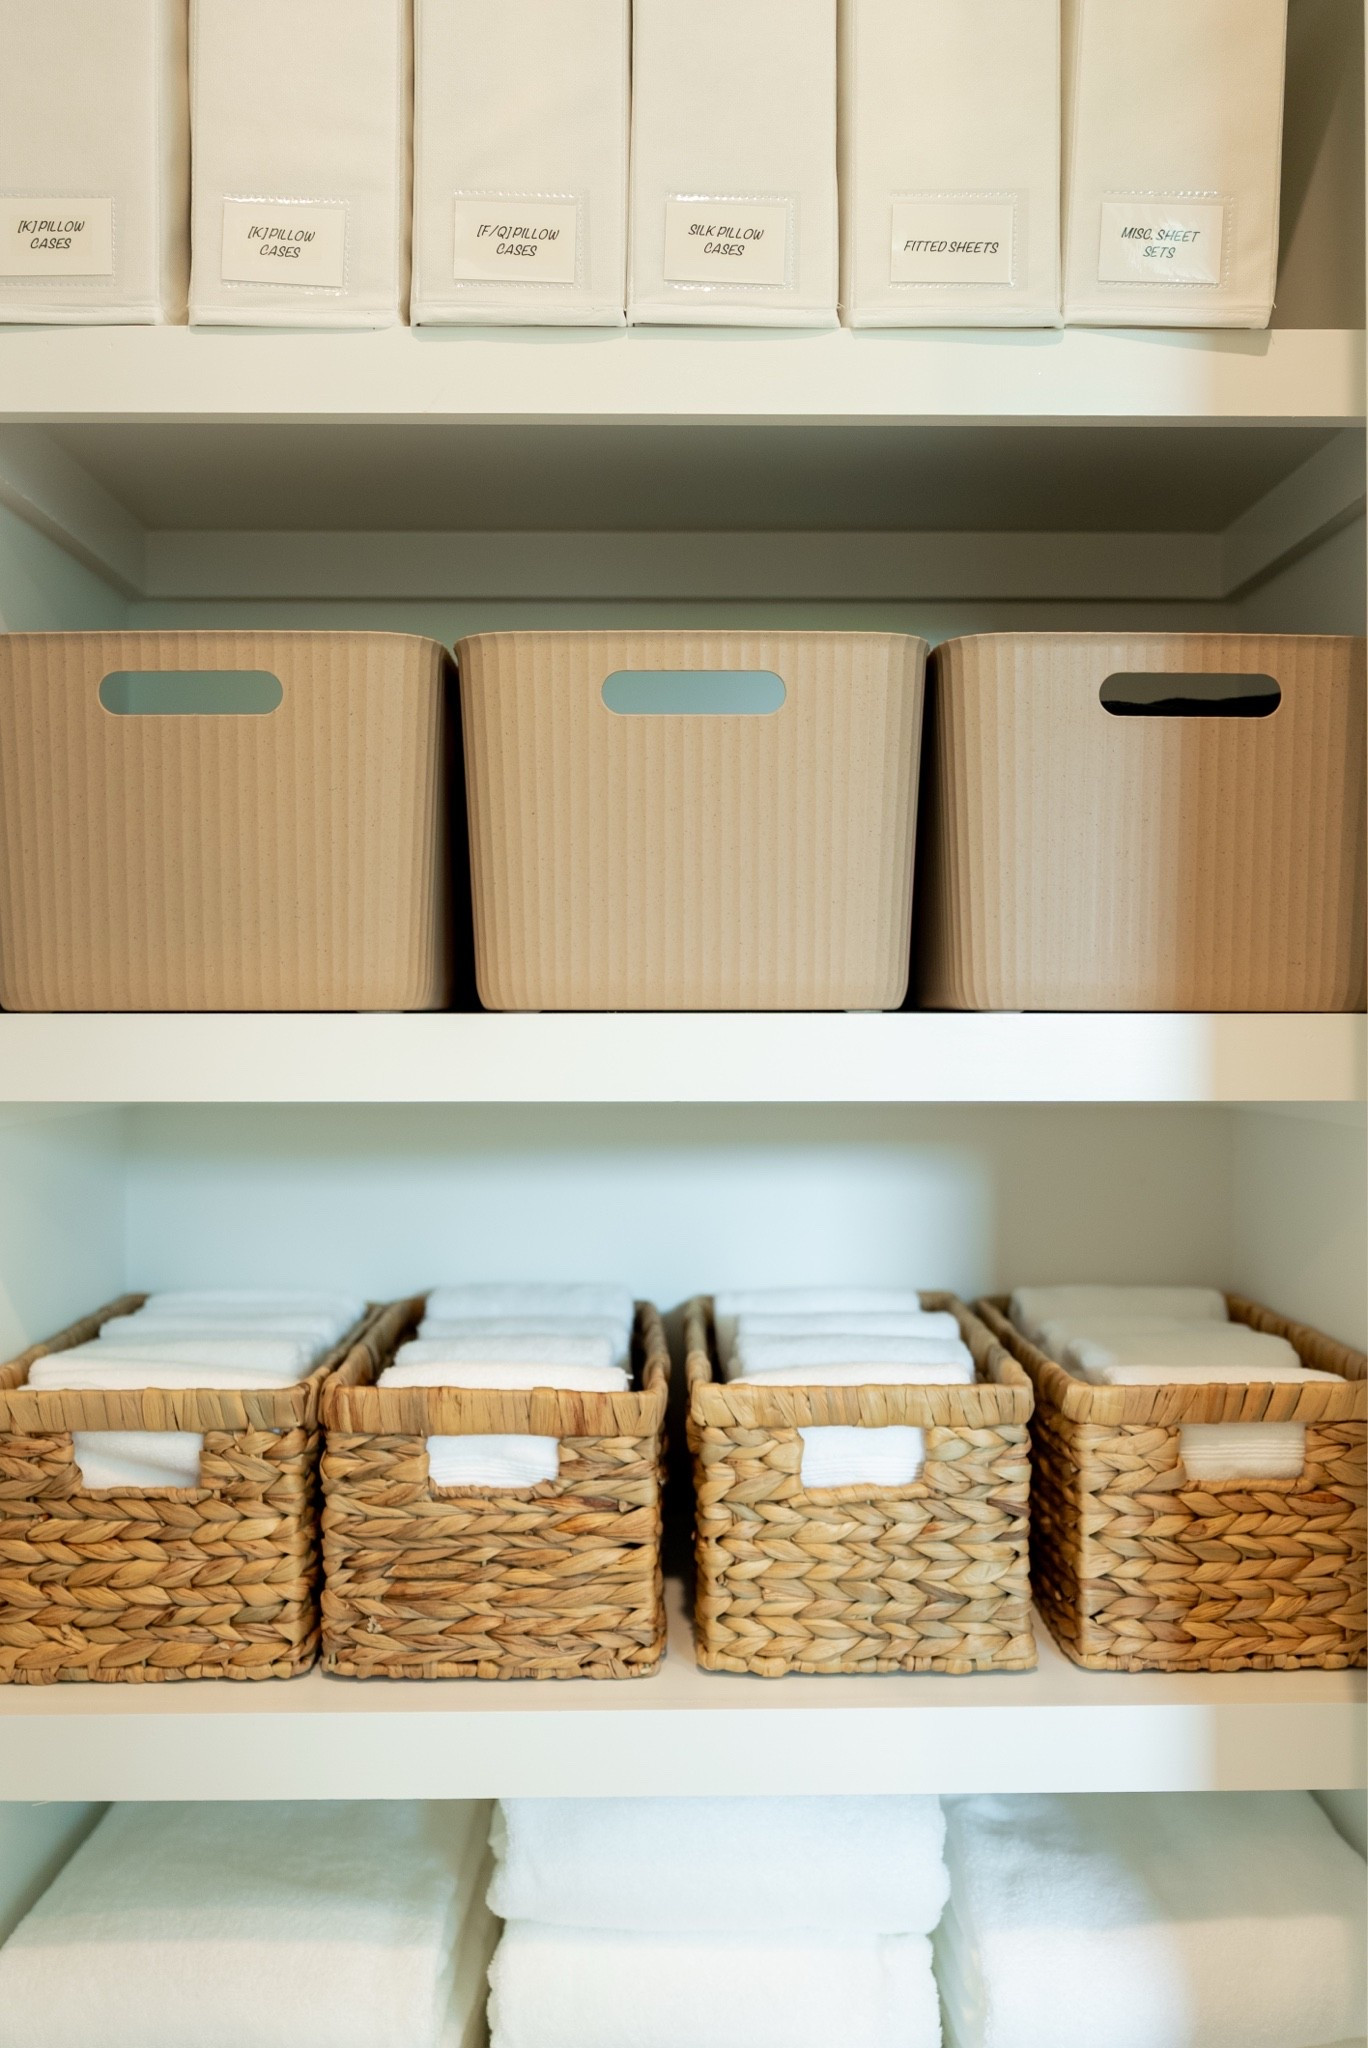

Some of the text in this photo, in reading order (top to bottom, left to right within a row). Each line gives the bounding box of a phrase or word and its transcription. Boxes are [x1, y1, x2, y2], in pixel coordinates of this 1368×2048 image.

[688, 223, 764, 239] SILK PILLOW
[1121, 227, 1200, 242] MISC. SHEET
[30, 238, 71, 249] CASES
[496, 243, 537, 257] CASES
[703, 243, 745, 256] CASES
[904, 240, 999, 254] FITTED SHEETS
[259, 244, 301, 258] CASES
[1143, 246, 1175, 258] SETS
